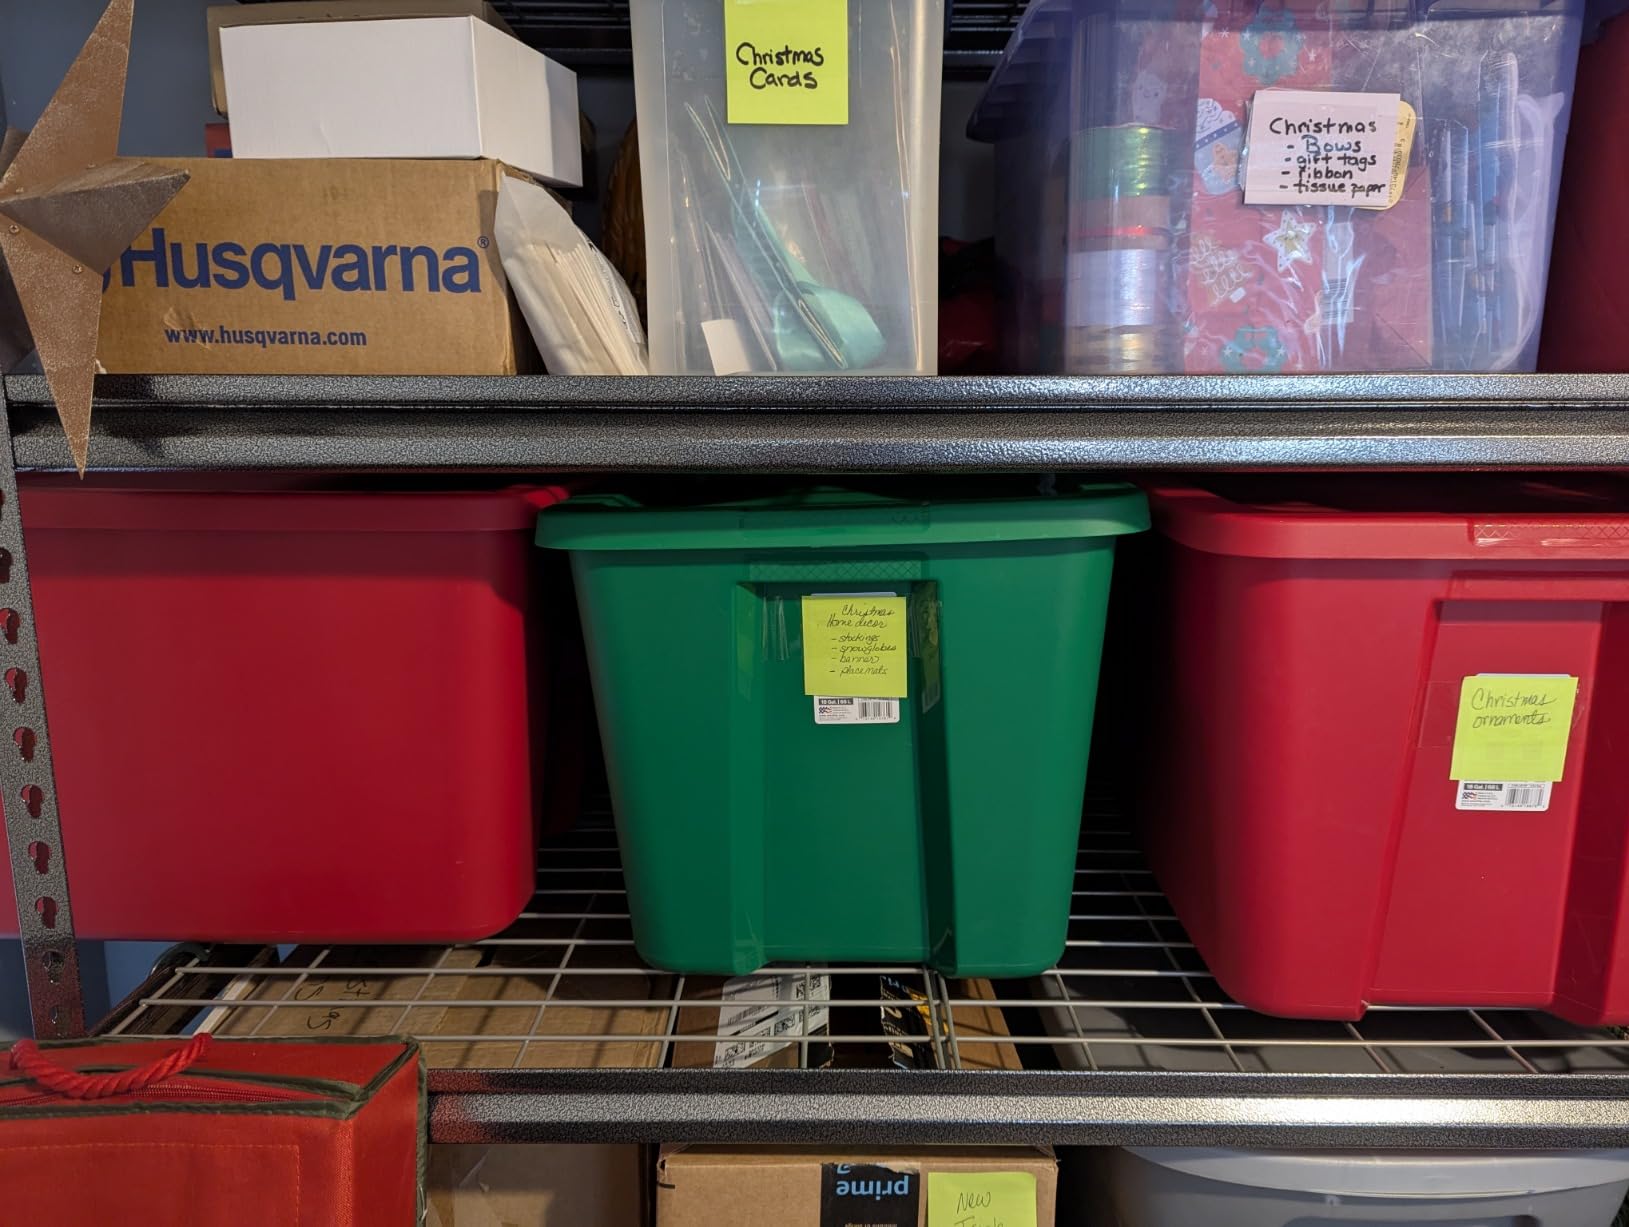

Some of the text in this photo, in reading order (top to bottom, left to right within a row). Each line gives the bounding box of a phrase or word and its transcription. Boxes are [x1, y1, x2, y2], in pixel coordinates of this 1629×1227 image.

[736, 42, 825, 67] Christmas
[749, 66, 818, 90] Cards
[1269, 117, 1377, 136] Christmas
[1301, 134, 1362, 154] Bows
[1296, 153, 1333, 172] gift
[1337, 153, 1377, 172] tags
[1298, 166, 1354, 180] ribbon
[1293, 180, 1347, 194] tissue
[165, 325, 367, 349] www.husqvarna.com
[827, 612, 887, 629] Home decor
[842, 605, 894, 618] Christmas
[1471, 688, 1557, 710] Christmas
[1472, 710, 1552, 728] ornaments
[836, 1175, 909, 1201] prime
[956, 1191, 992, 1214] New
